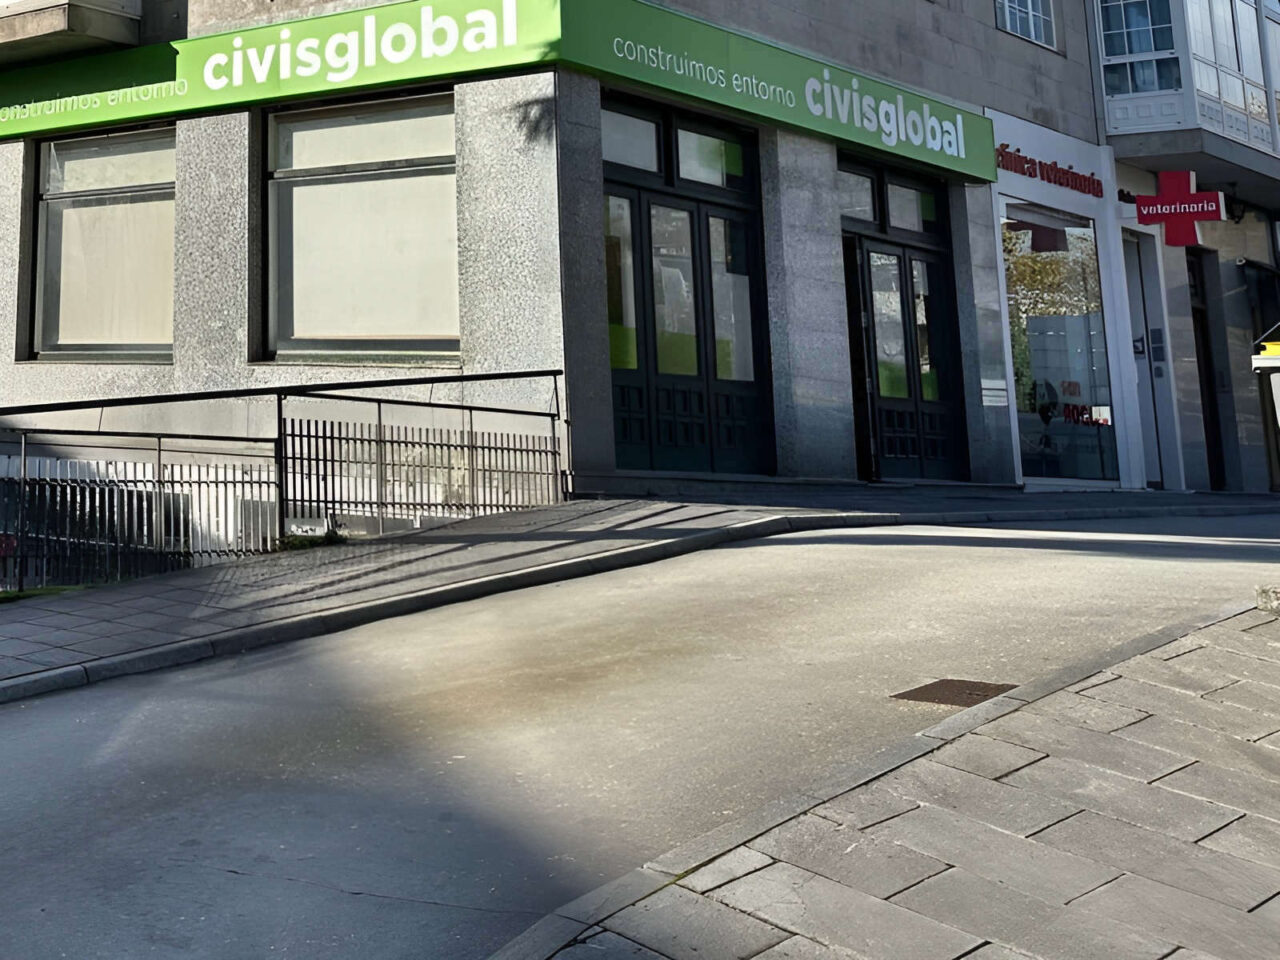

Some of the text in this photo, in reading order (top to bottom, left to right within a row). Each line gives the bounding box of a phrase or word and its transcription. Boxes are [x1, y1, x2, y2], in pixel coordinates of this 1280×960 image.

[107, 79, 188, 106] entorno
[614, 37, 966, 159] construimos entorno civisglobal
[1141, 200, 1216, 215] veterinaria
